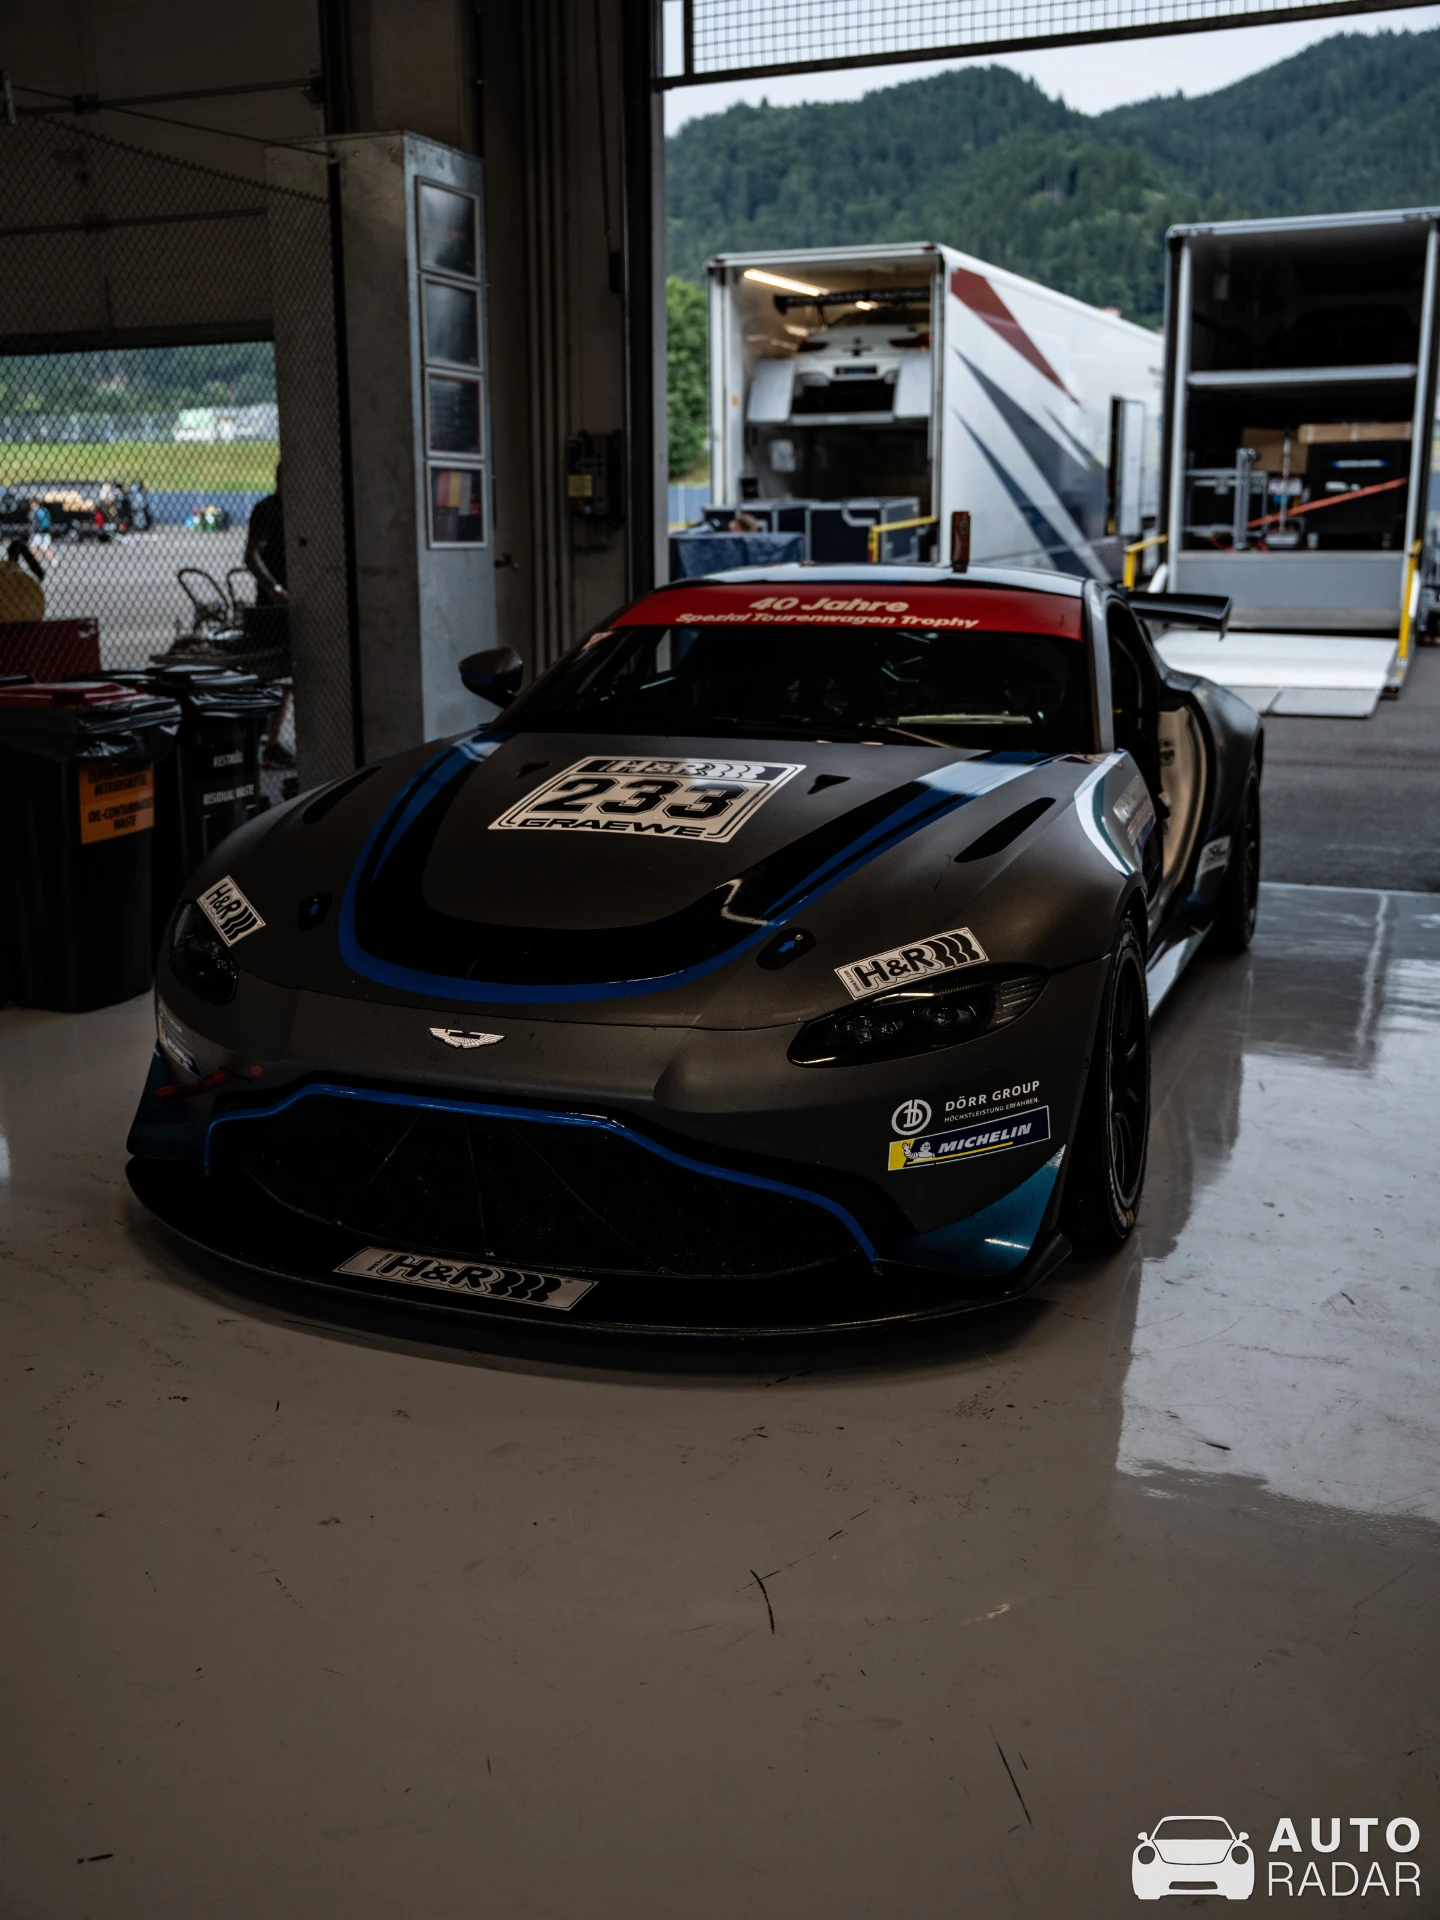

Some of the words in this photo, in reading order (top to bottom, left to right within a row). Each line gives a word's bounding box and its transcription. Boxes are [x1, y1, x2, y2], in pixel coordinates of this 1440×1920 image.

[675, 612, 751, 624] Spezial
[753, 612, 897, 625] Tourenwagen
[899, 615, 980, 629] Trophy
[748, 596, 800, 611] 40
[800, 597, 910, 613] Jahre
[235, 783, 256, 799] WASTE
[526, 777, 749, 821] 233
[517, 818, 707, 837] GRAEWE
[206, 883, 242, 920] H&R
[853, 948, 935, 988] H&R
[944, 1105, 1005, 1123] HÖCHSTLEISTUNG
[1005, 1096, 1040, 1110] ERFAHREN.
[945, 1094, 987, 1112] DÖRR
[992, 1080, 1040, 1101] GROUP
[937, 1122, 1033, 1154] MICHELIN
[379, 1255, 495, 1288] H&R
